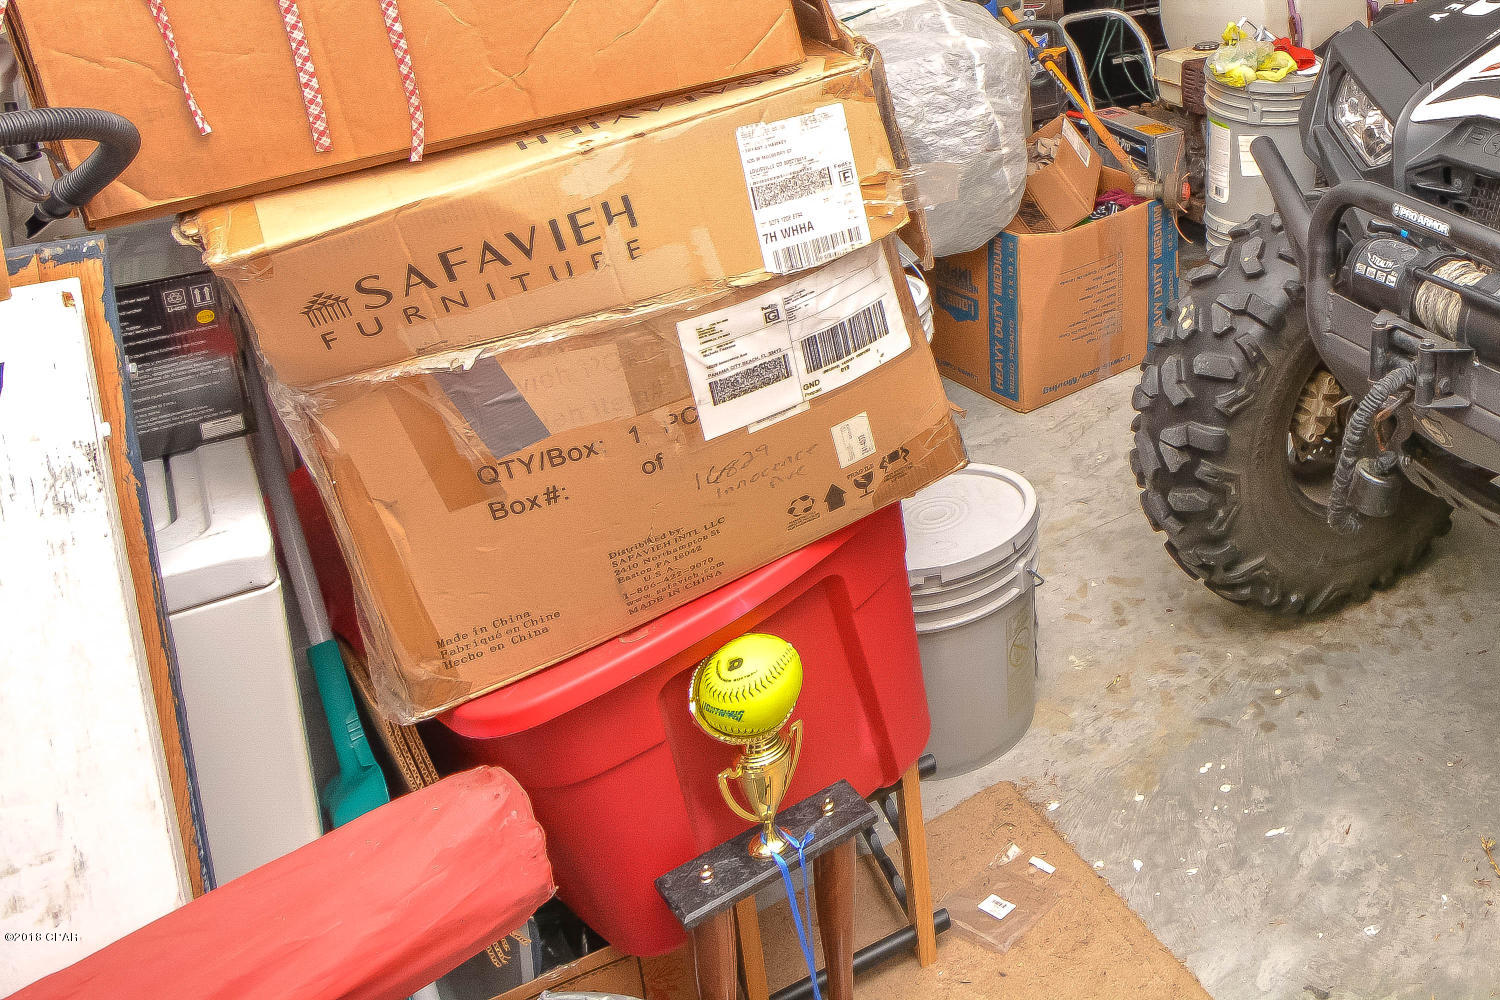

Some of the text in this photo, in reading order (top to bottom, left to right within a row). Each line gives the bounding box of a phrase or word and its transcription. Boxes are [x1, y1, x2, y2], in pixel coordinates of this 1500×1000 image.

[763, 220, 815, 245] 7H WHHA
[1400, 206, 1449, 237] PRO ARMOR
[354, 194, 638, 311] SAFAVIEH
[1370, 256, 1394, 269] STEALTH
[1153, 263, 1163, 298] DUTY
[993, 298, 1003, 338] DUTY
[803, 379, 821, 391] GND
[476, 438, 604, 487] QTY/Box:
[641, 453, 664, 475] of
[487, 484, 570, 522] Box#:
[611, 541, 671, 568] SAFAVIEH
[703, 516, 725, 531] LLC
[613, 562, 638, 576] 2410
[642, 534, 709, 564] Northampton
[673, 545, 703, 561] 18042
[628, 595, 664, 615] MADE
[685, 570, 722, 590] CHINA
[436, 610, 531, 649] Made in China
[505, 626, 521, 636] en
[523, 610, 560, 629] Chine
[442, 626, 549, 670] Hecho en China
